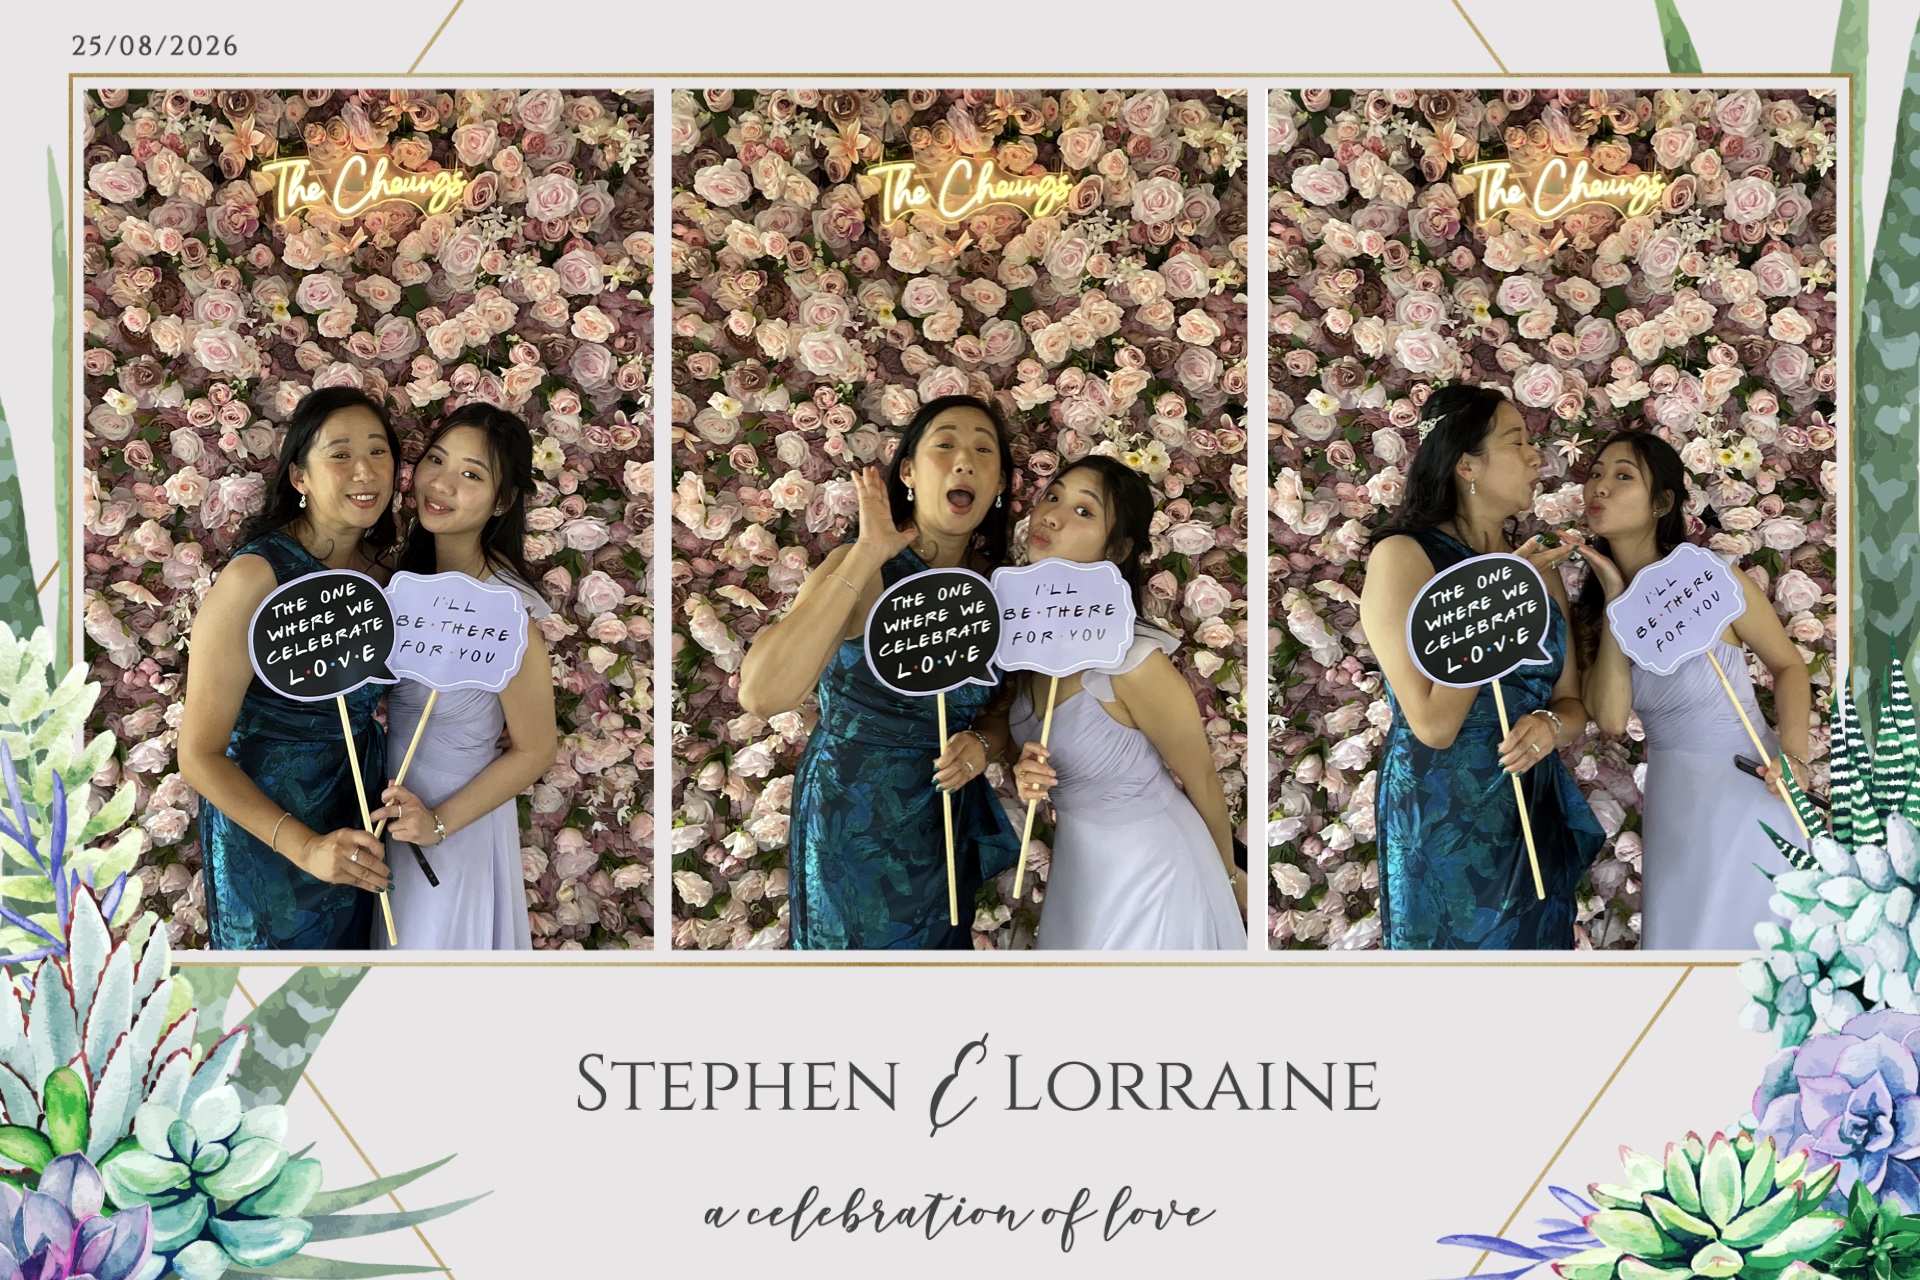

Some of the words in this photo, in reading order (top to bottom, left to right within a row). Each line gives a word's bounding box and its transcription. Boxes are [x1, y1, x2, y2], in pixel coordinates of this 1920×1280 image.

[261, 159, 325, 219] The
[332, 155, 467, 214] Cheungs
[867, 162, 931, 222] The
[939, 158, 1073, 217] Cheungs
[1463, 161, 1526, 221] The
[1533, 158, 1667, 217] Cheungs
[272, 597, 308, 619] THE
[320, 582, 357, 604] ONE
[891, 592, 926, 612] THE
[937, 582, 973, 600] ONE
[1424, 596, 1492, 631] WHERE
[1502, 581, 1529, 600] WE
[1429, 584, 1465, 607] THE
[1477, 566, 1512, 589] ONE
[267, 611, 335, 642] WHERE
[346, 598, 374, 617] WE
[878, 619, 992, 657] CELEBRATE
[883, 608, 949, 635] WHERE
[960, 600, 986, 616] WE
[1012, 631, 1053, 645] FOR
[1069, 628, 1106, 641] YOU
[1424, 599, 1538, 655] CELEBRATE
[1655, 620, 1686, 652] FOR
[1693, 590, 1720, 617] YOU
[266, 617, 384, 665] CELEBRATE
[400, 640, 442, 657] FOR
[459, 648, 495, 663] YOU
